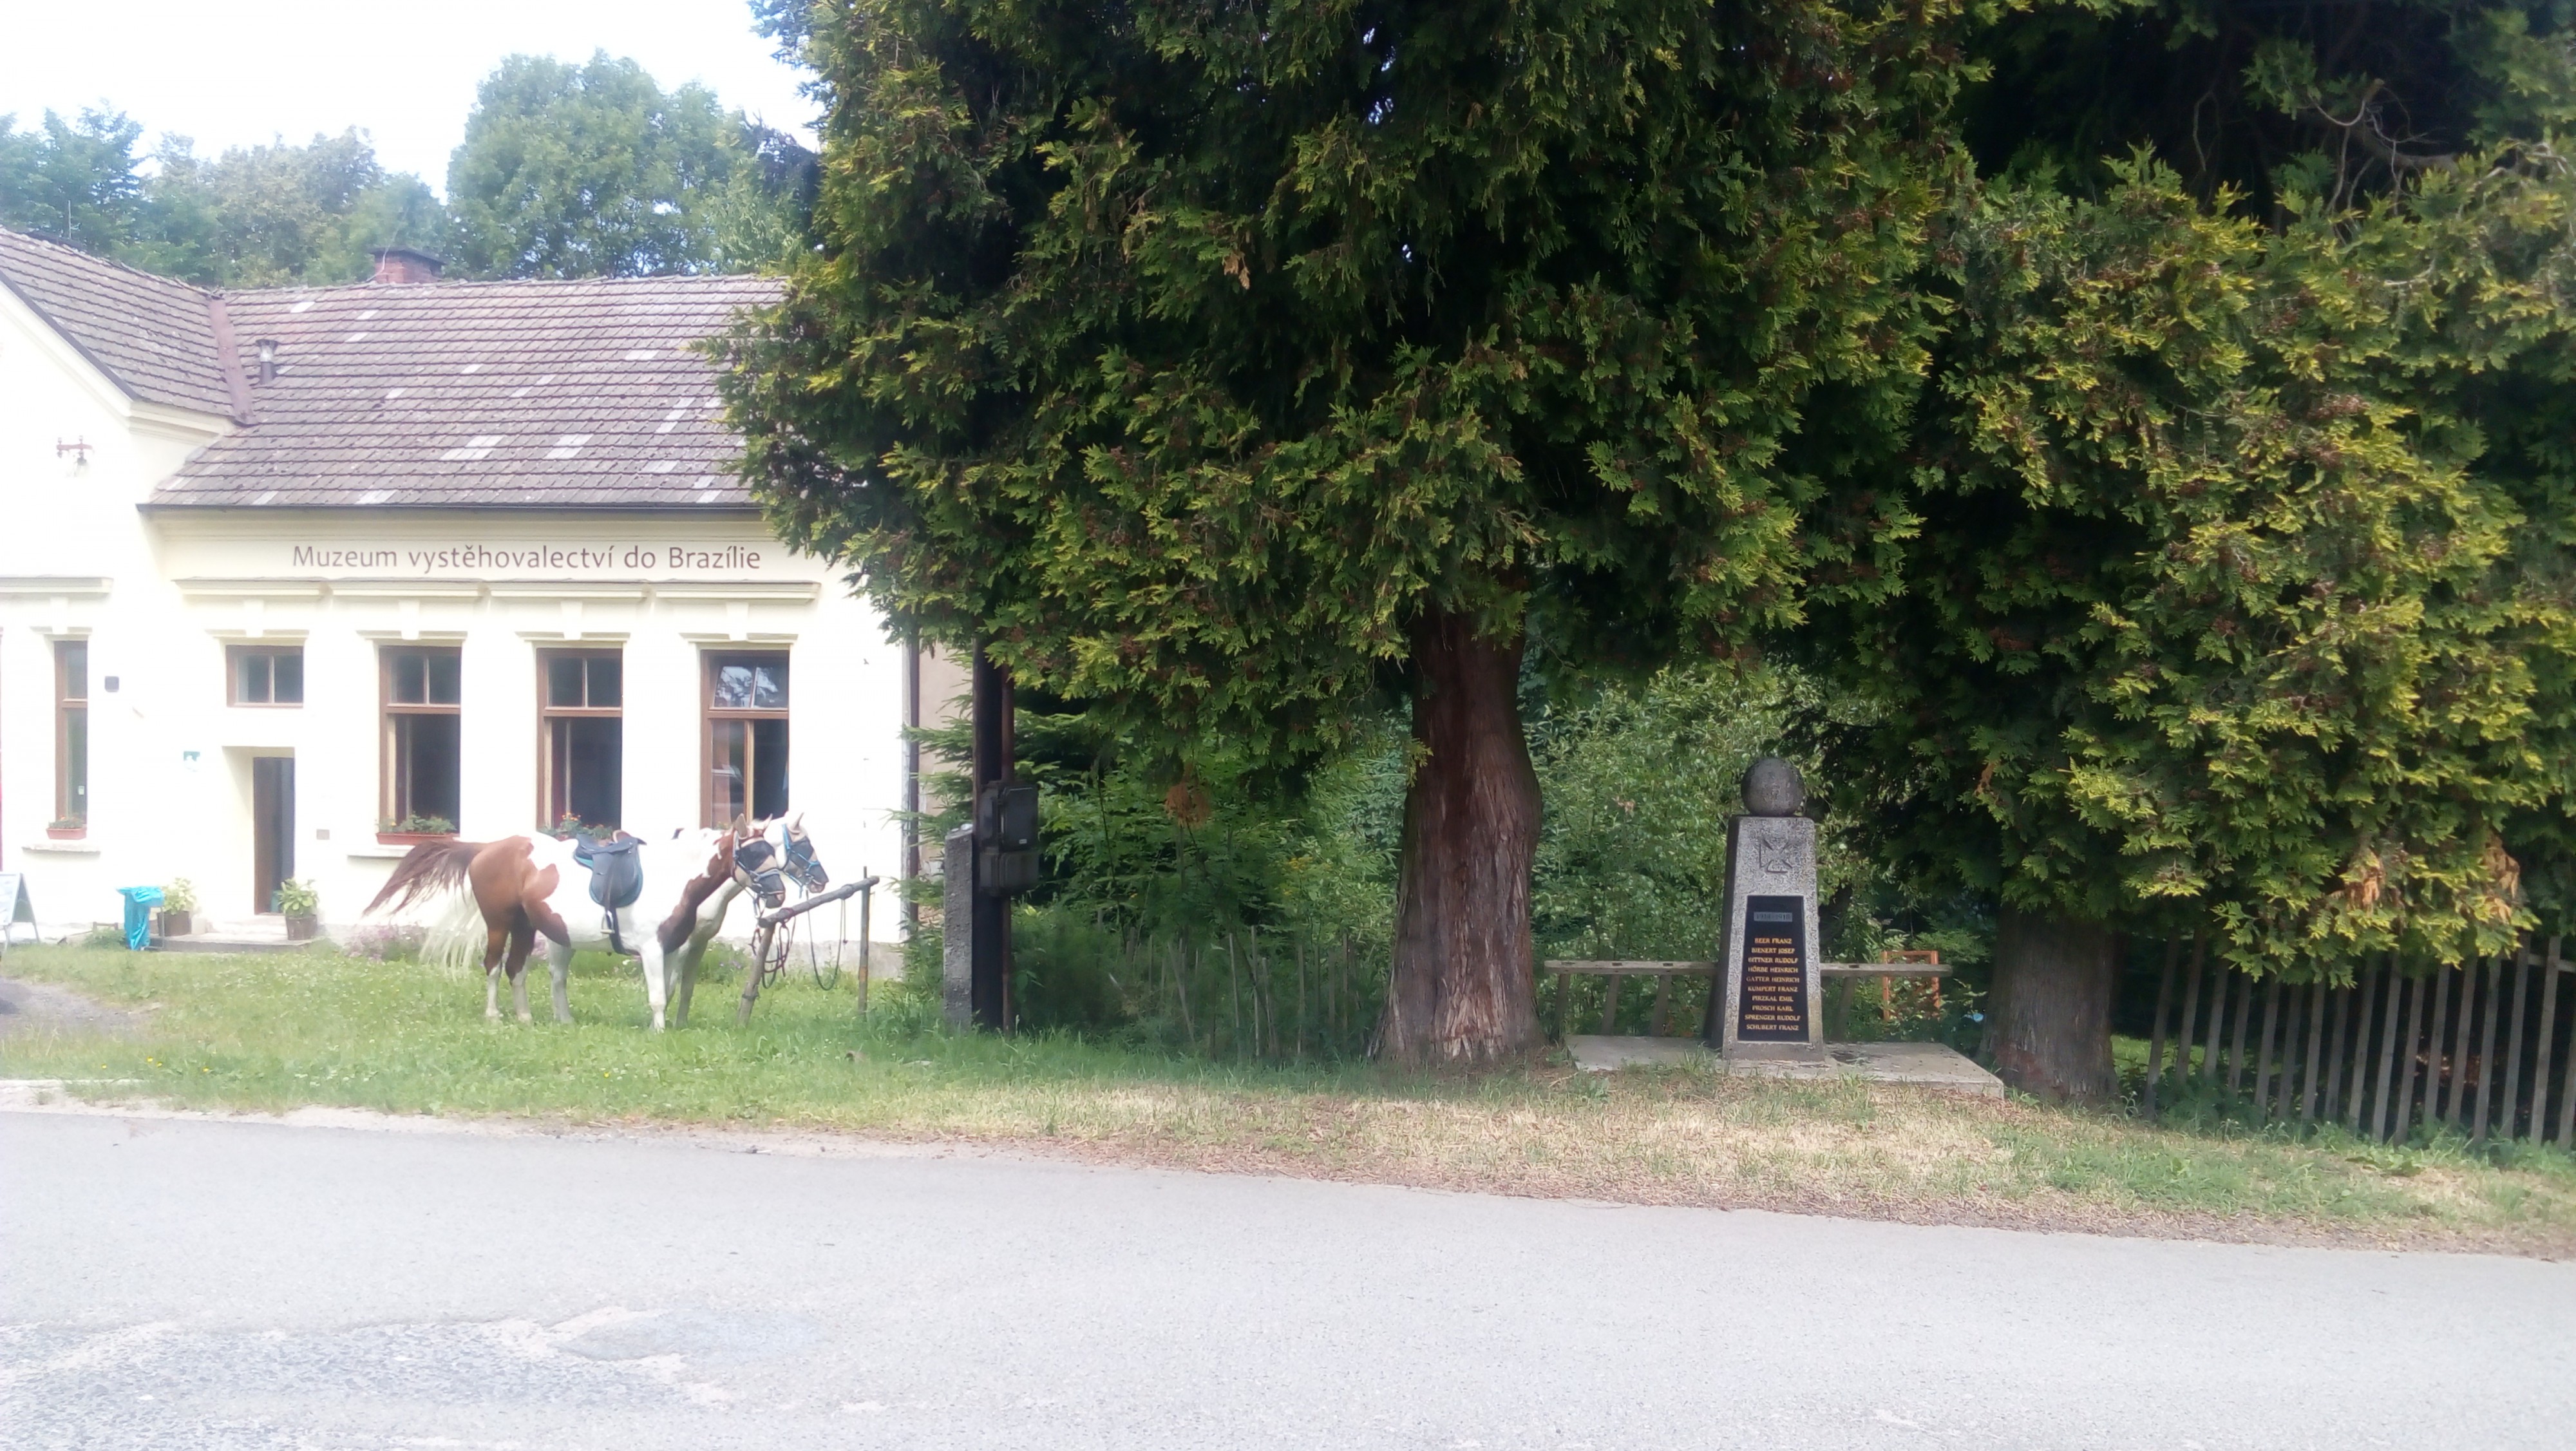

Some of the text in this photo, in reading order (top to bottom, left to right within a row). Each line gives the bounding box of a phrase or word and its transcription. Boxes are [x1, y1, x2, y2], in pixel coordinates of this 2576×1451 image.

[293, 544, 761, 574] Muzeum vystěhovalectví do Brazílie
